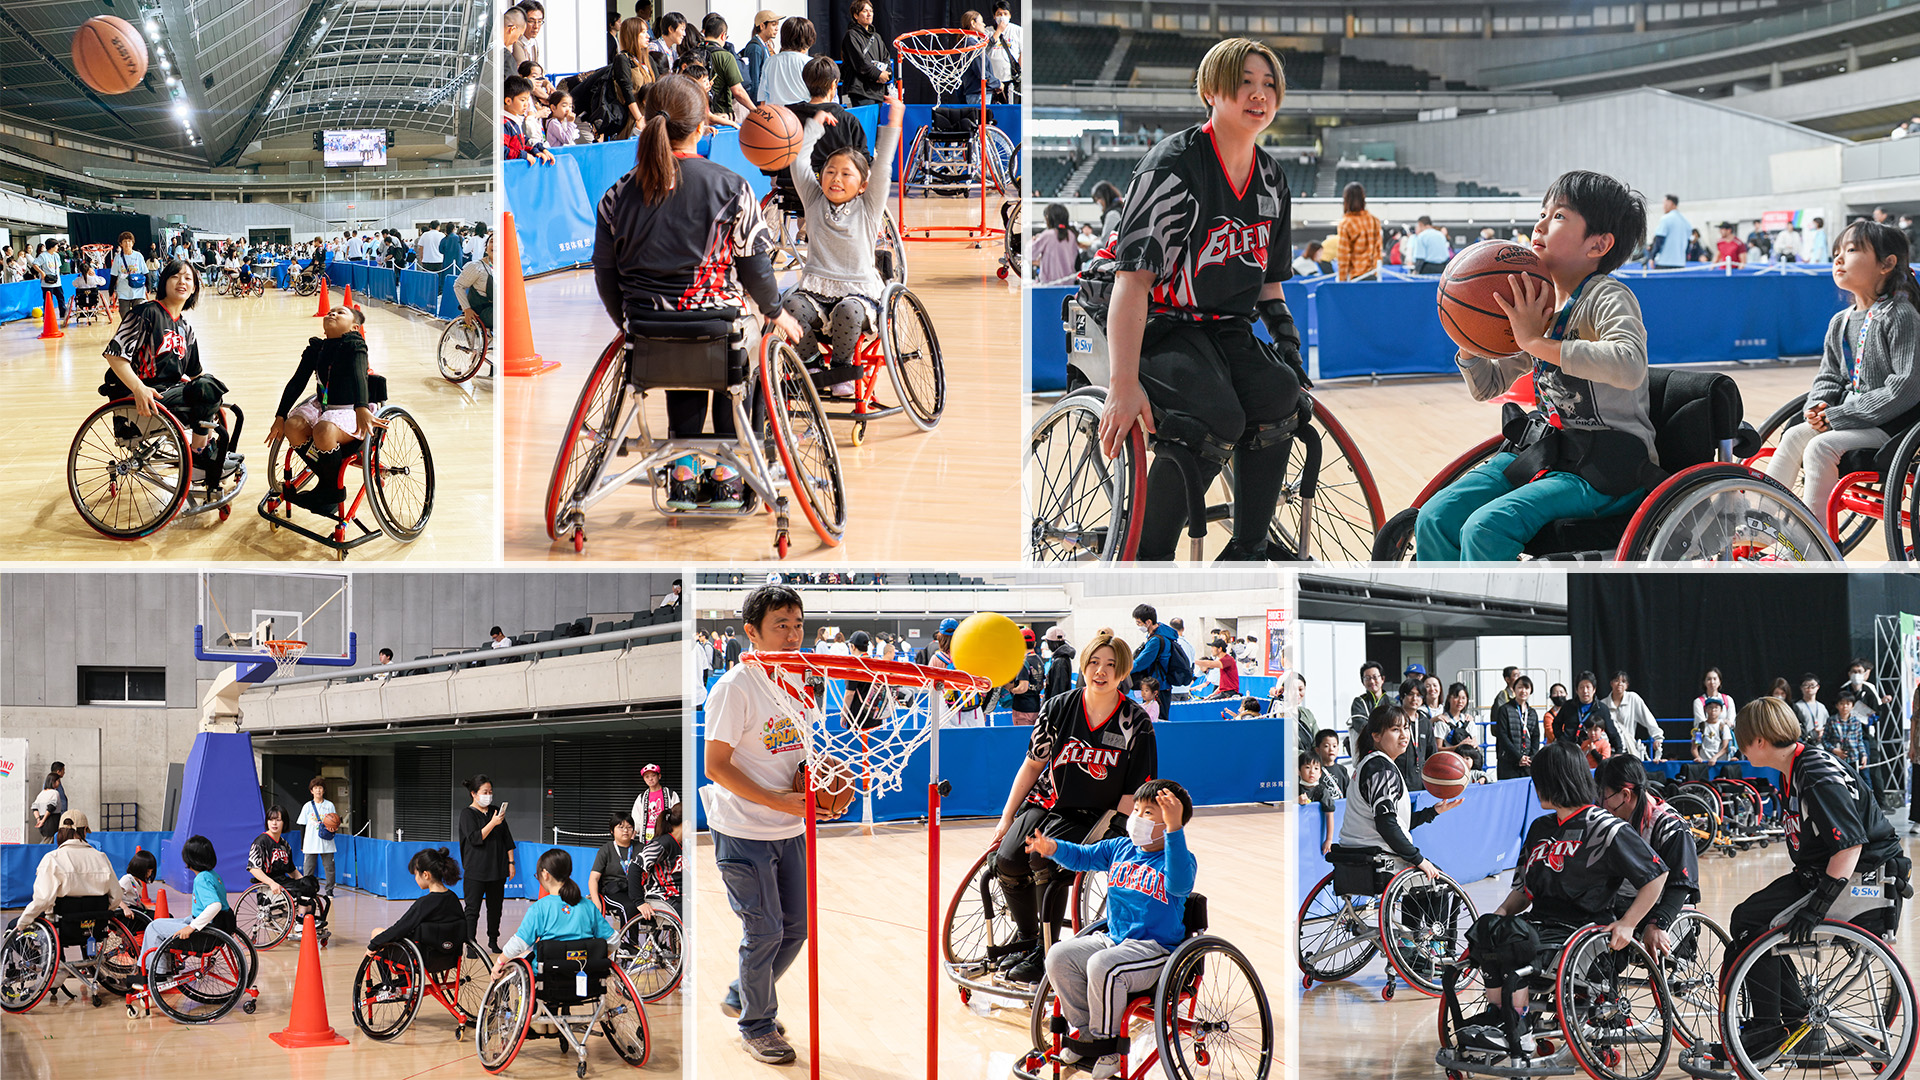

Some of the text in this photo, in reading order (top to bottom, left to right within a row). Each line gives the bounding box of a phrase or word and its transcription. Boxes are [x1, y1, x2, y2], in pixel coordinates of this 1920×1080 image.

[1194, 220, 1272, 278] ELFIN
[1080, 339, 1093, 353] Sky
[1053, 740, 1122, 771] ELFIN
[1107, 861, 1169, 905] LORIDA
[1860, 887, 1880, 897] Sky
